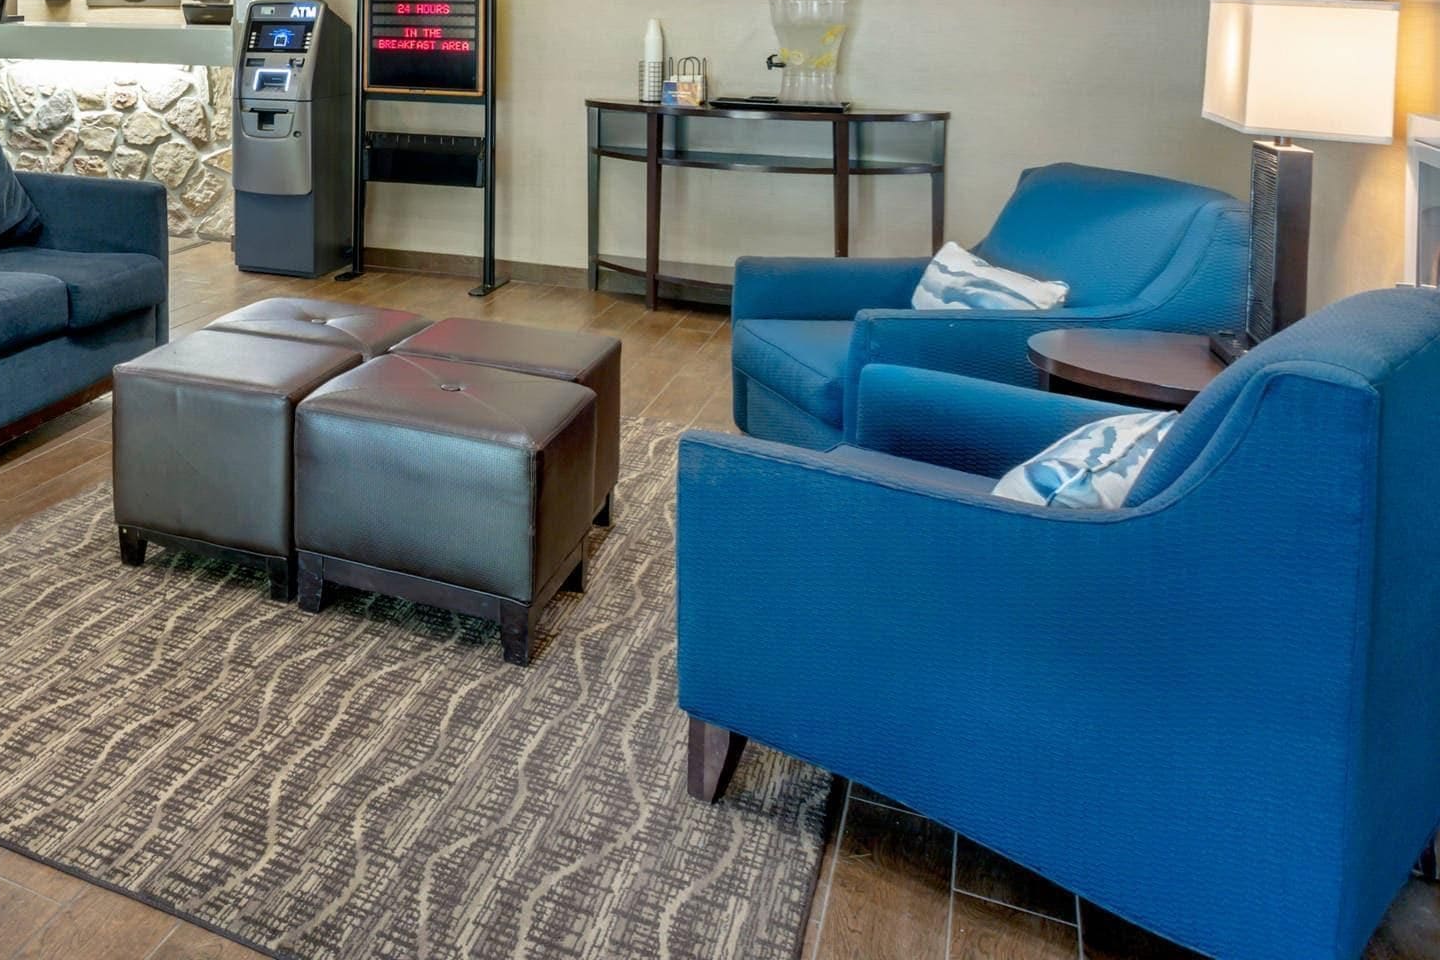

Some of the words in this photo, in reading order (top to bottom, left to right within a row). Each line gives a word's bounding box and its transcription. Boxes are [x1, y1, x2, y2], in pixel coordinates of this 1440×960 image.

[290, 6, 317, 18] ATM
[398, 4, 410, 14] 24
[416, 4, 450, 14] HOURS
[405, 28, 417, 38] IN
[423, 28, 442, 38] THE
[378, 39, 436, 49] BREAKFAST
[441, 41, 469, 51] AREA
